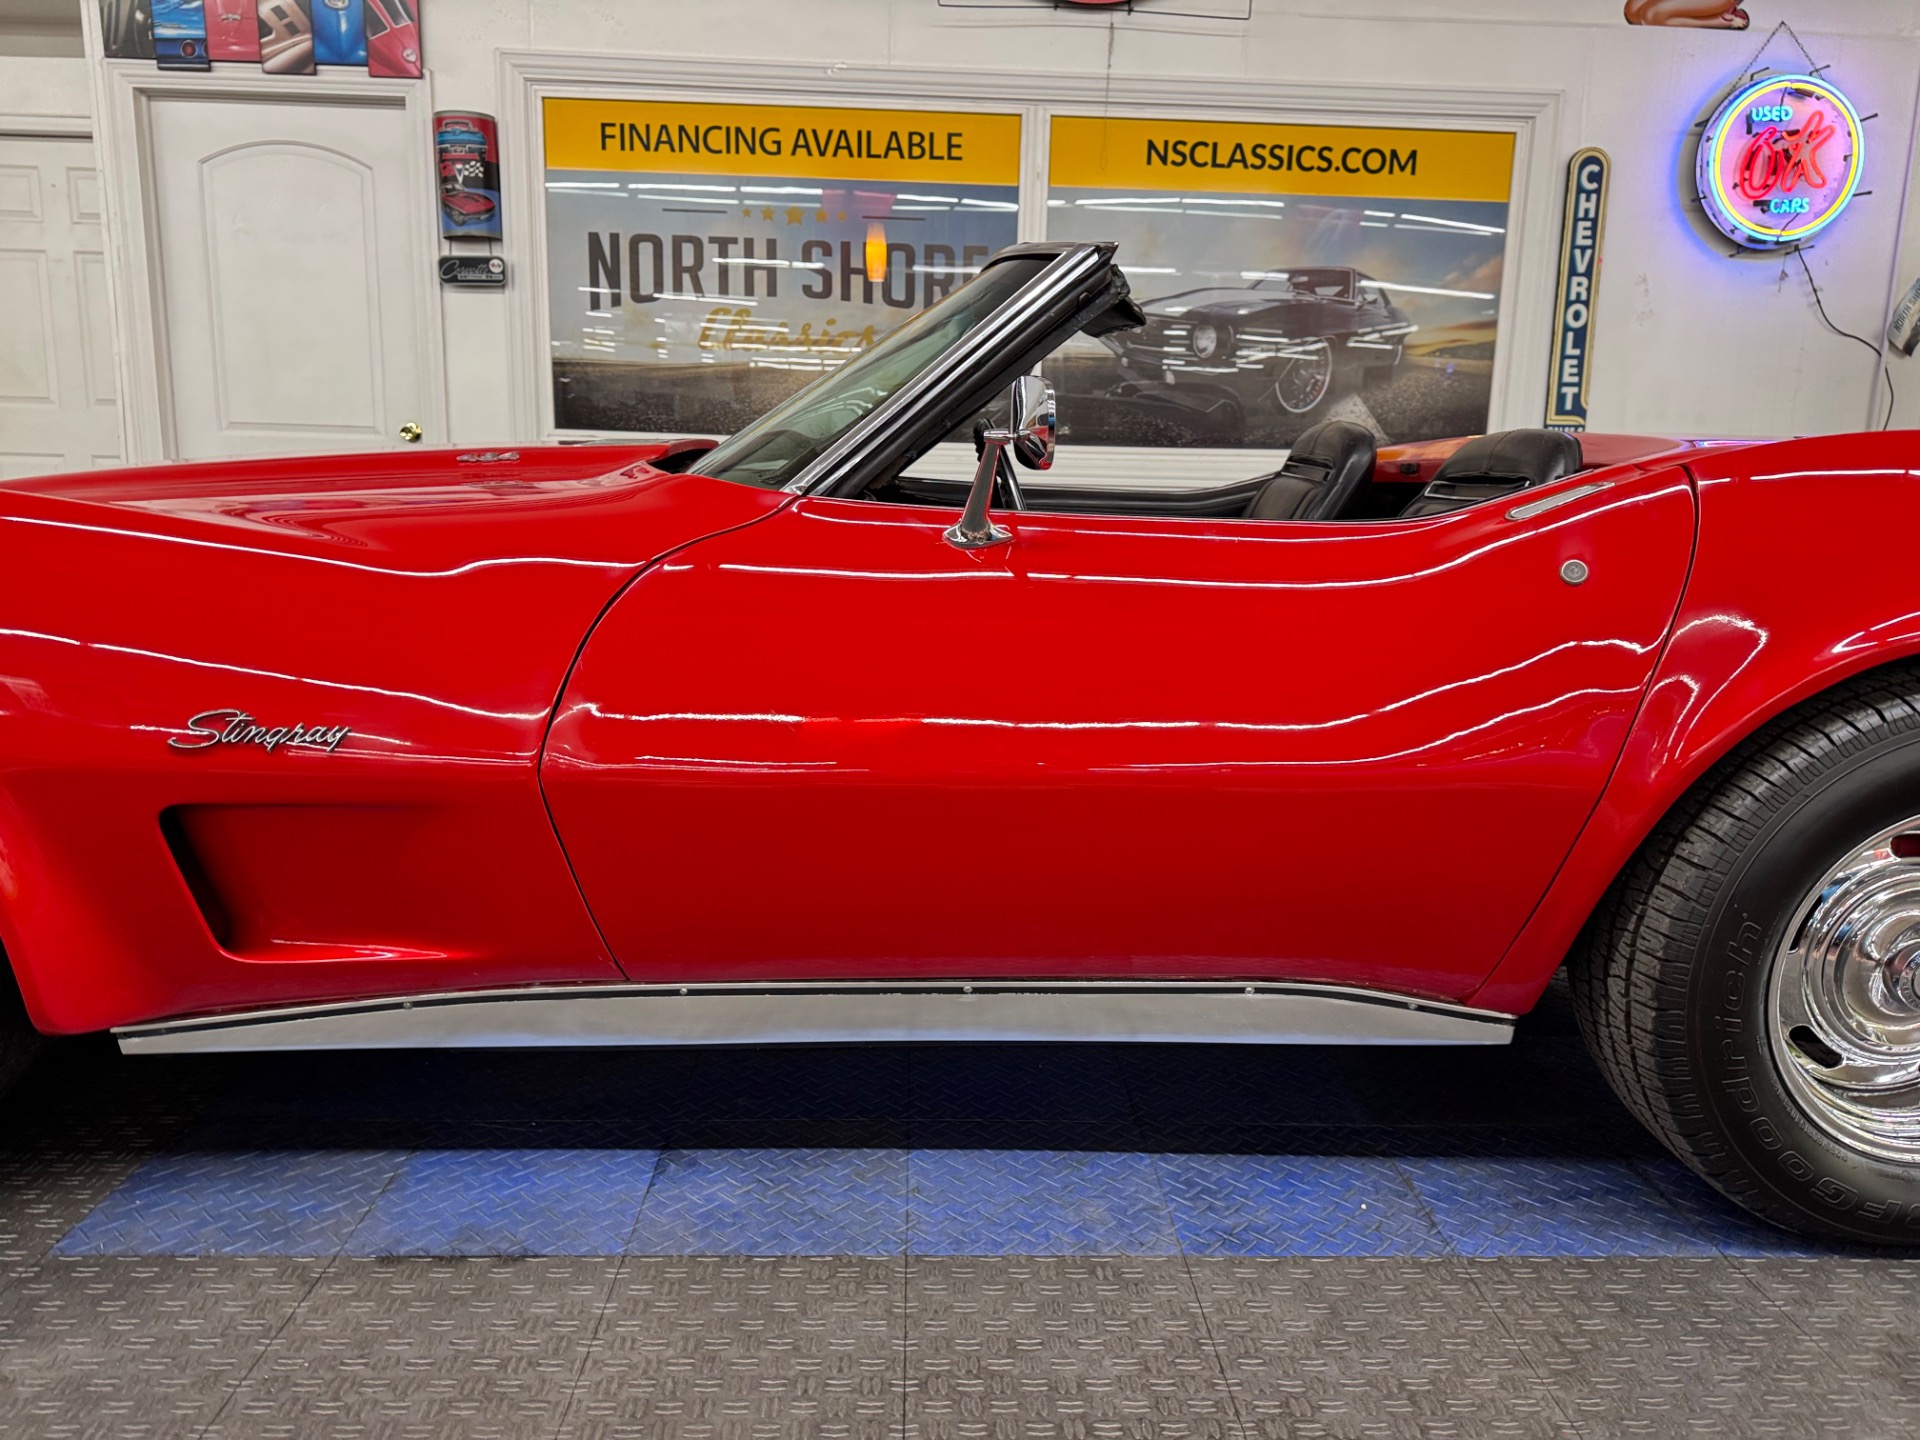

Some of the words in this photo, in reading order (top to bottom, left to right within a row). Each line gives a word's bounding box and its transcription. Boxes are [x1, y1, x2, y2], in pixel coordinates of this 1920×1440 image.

[1751, 105, 1794, 122] USED
[600, 122, 782, 155] FINANCING
[790, 128, 963, 162] AVAILABLE
[1146, 138, 1418, 176] NSCLASSICS.COM
[1740, 110, 1836, 200] OK
[1769, 197, 1810, 214] CARS
[587, 231, 778, 311] NORTH
[1560, 163, 1601, 411] CHEVROLET
[698, 307, 875, 353] Classics
[167, 708, 351, 753] Stingray
